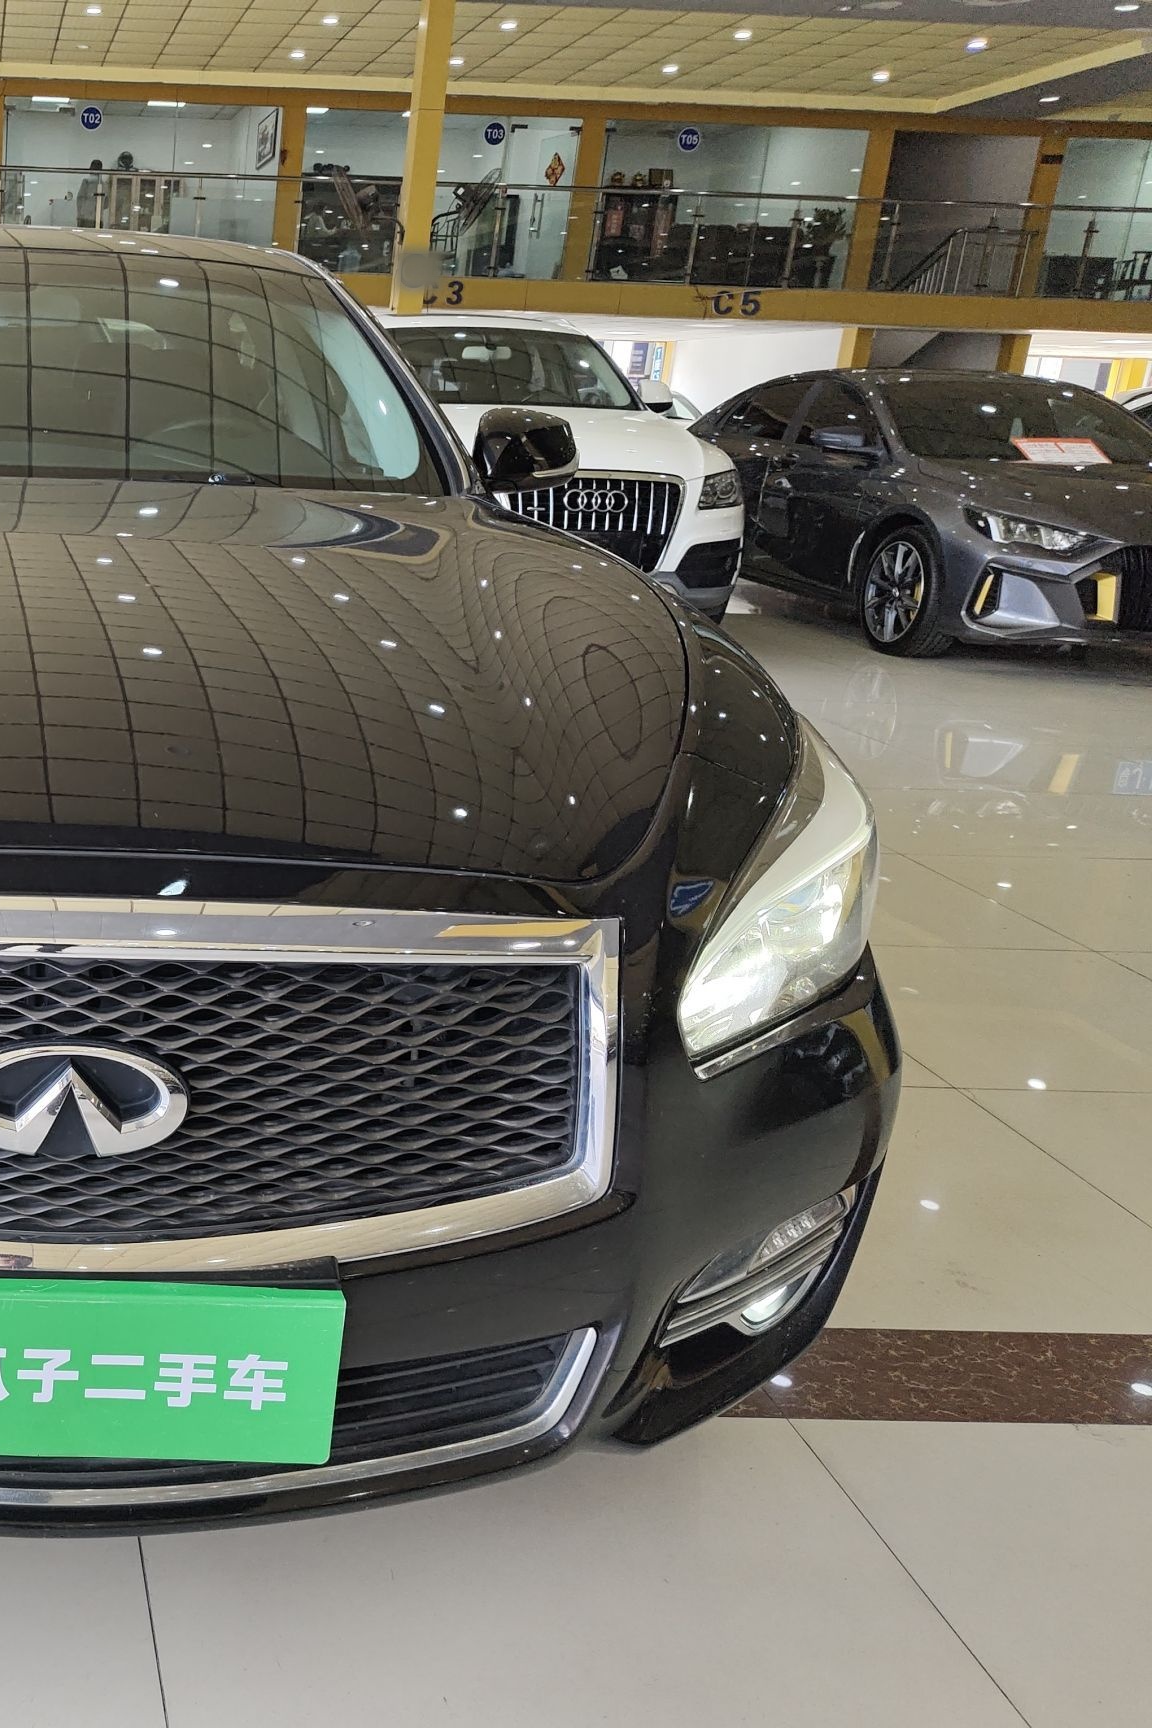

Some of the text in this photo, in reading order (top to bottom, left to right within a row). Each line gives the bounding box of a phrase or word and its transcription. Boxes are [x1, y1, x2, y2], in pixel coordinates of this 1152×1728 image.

[82, 113, 101, 124] T02
[486, 128, 504, 139] T03
[680, 134, 699, 145] T05
[713, 290, 761, 316] C5
